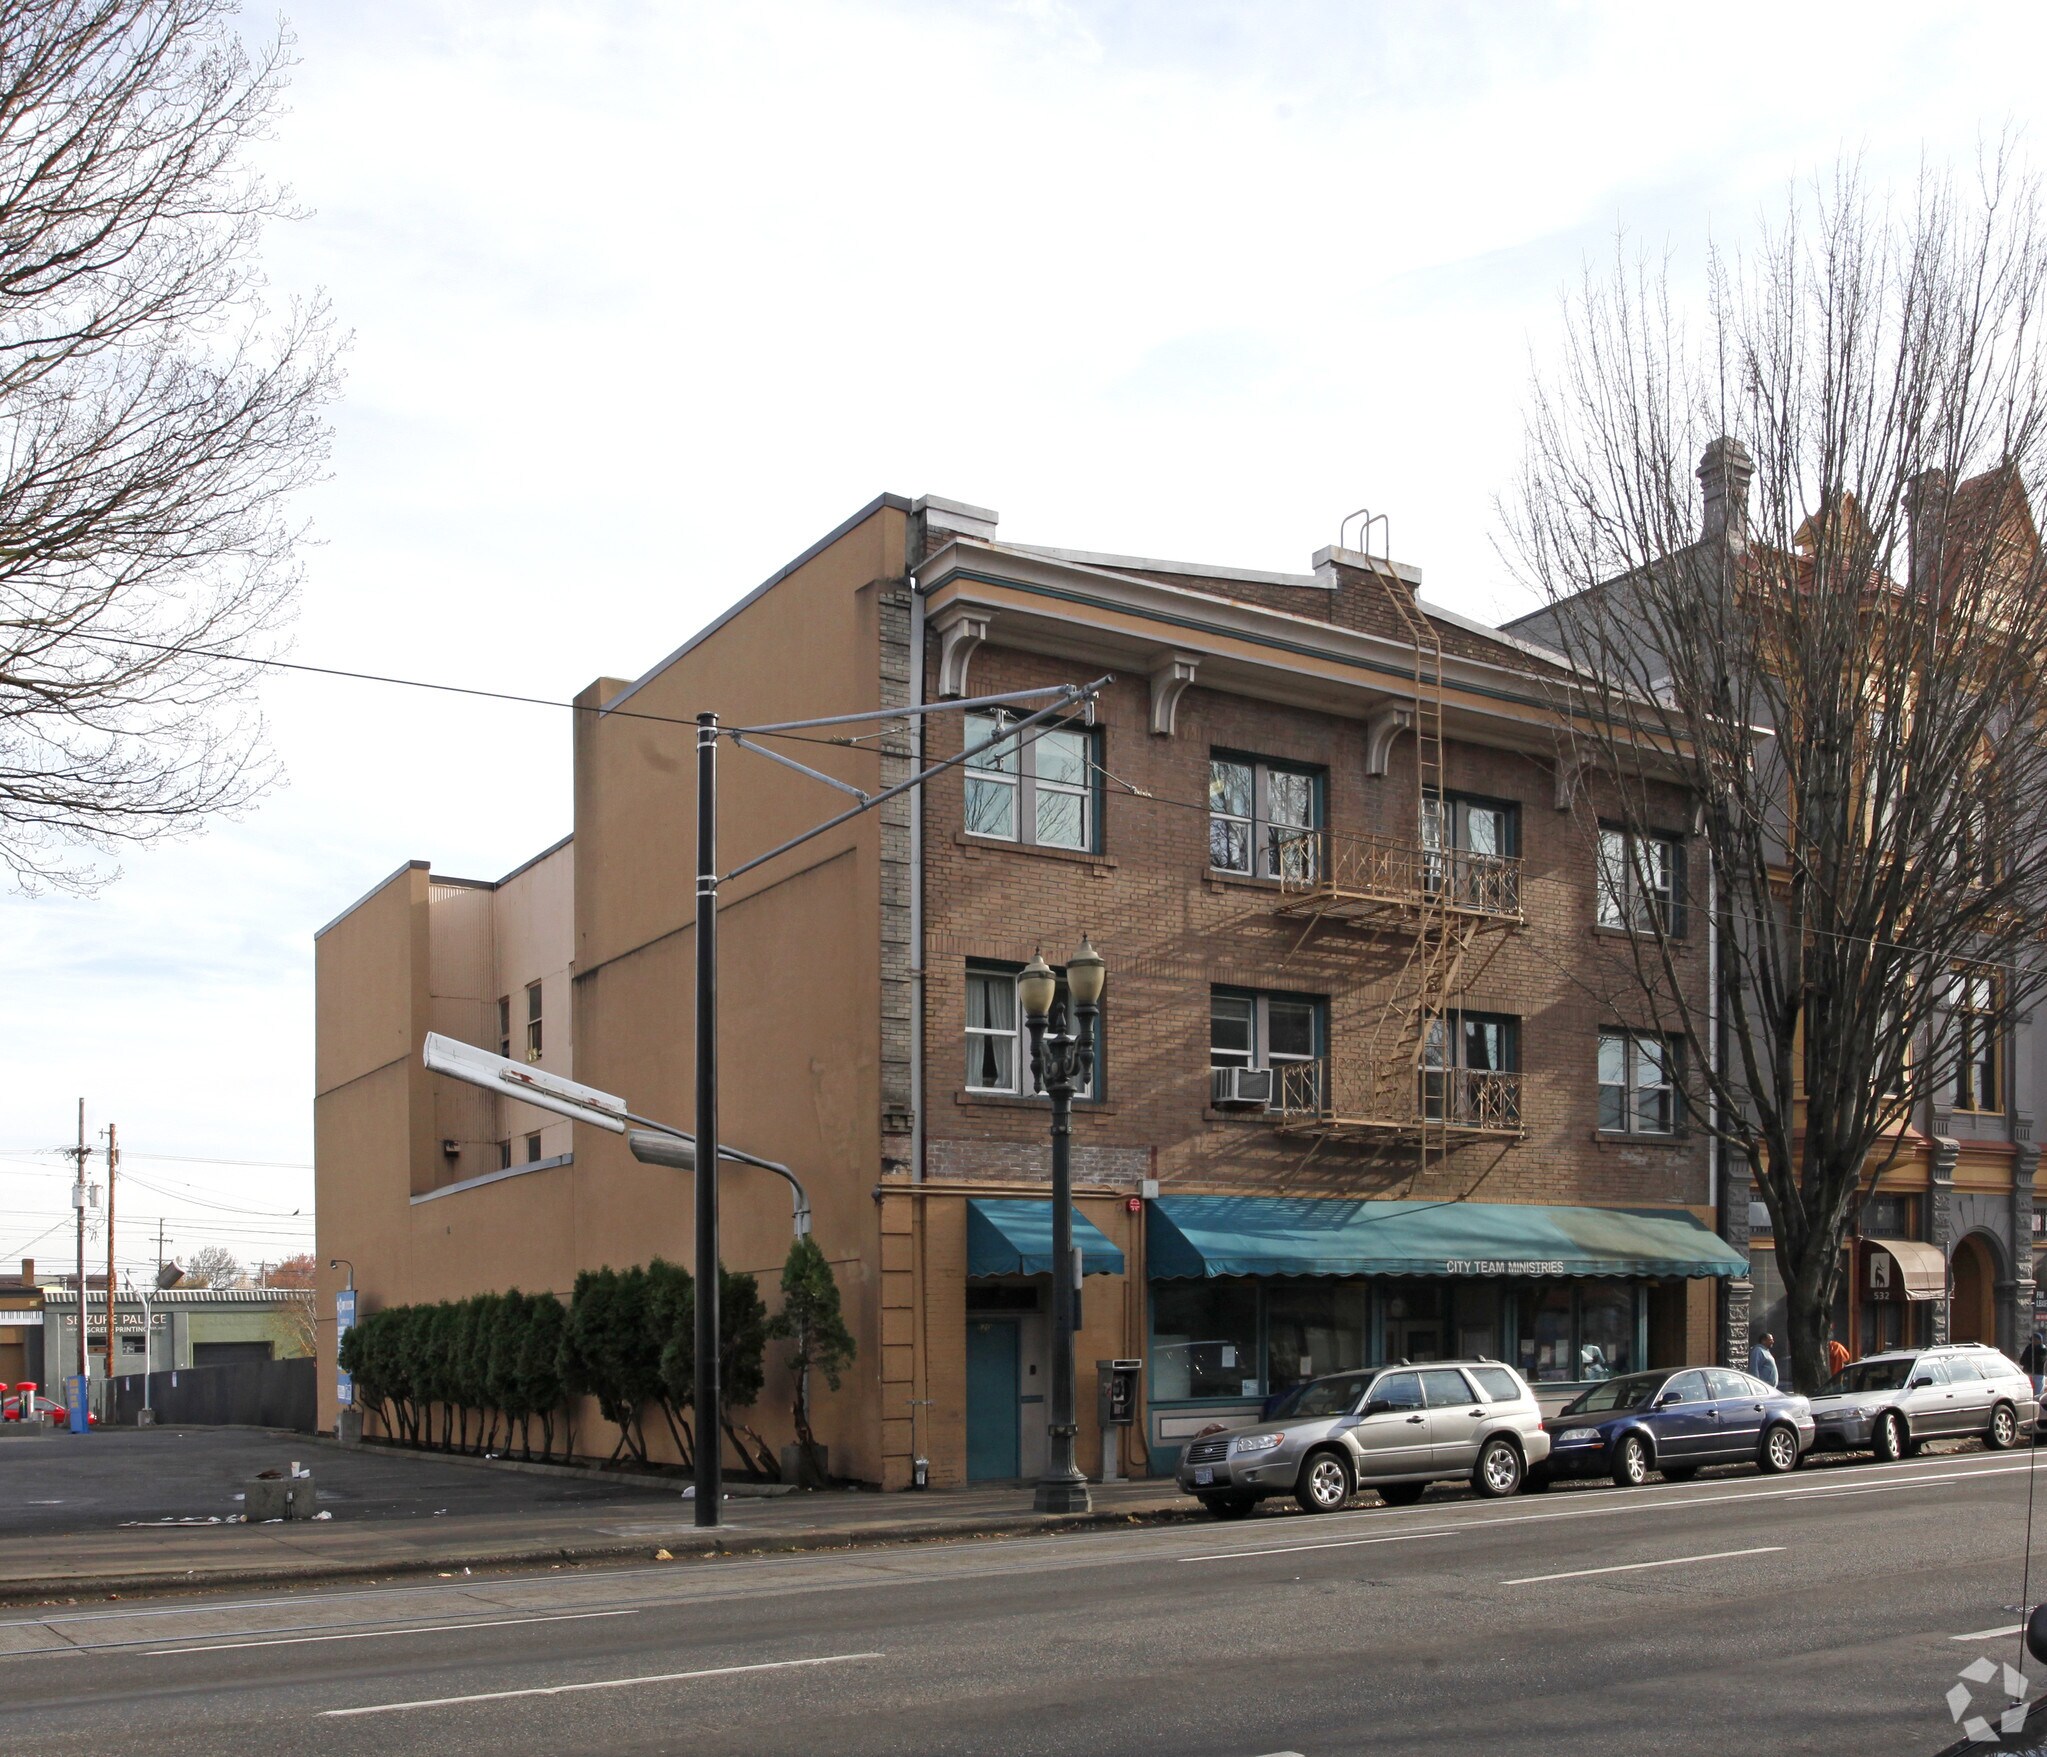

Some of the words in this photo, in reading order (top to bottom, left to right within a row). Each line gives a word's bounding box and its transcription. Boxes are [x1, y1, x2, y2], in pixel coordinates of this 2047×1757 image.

[1446, 1260, 1471, 1273] CITY
[1474, 1261, 1504, 1273] TEAM
[1508, 1261, 1564, 1273] MINISTRIES
[1873, 1291, 1890, 1300] 532
[66, 1314, 118, 1326] SEZURE
[123, 1314, 167, 1325] PALCE
